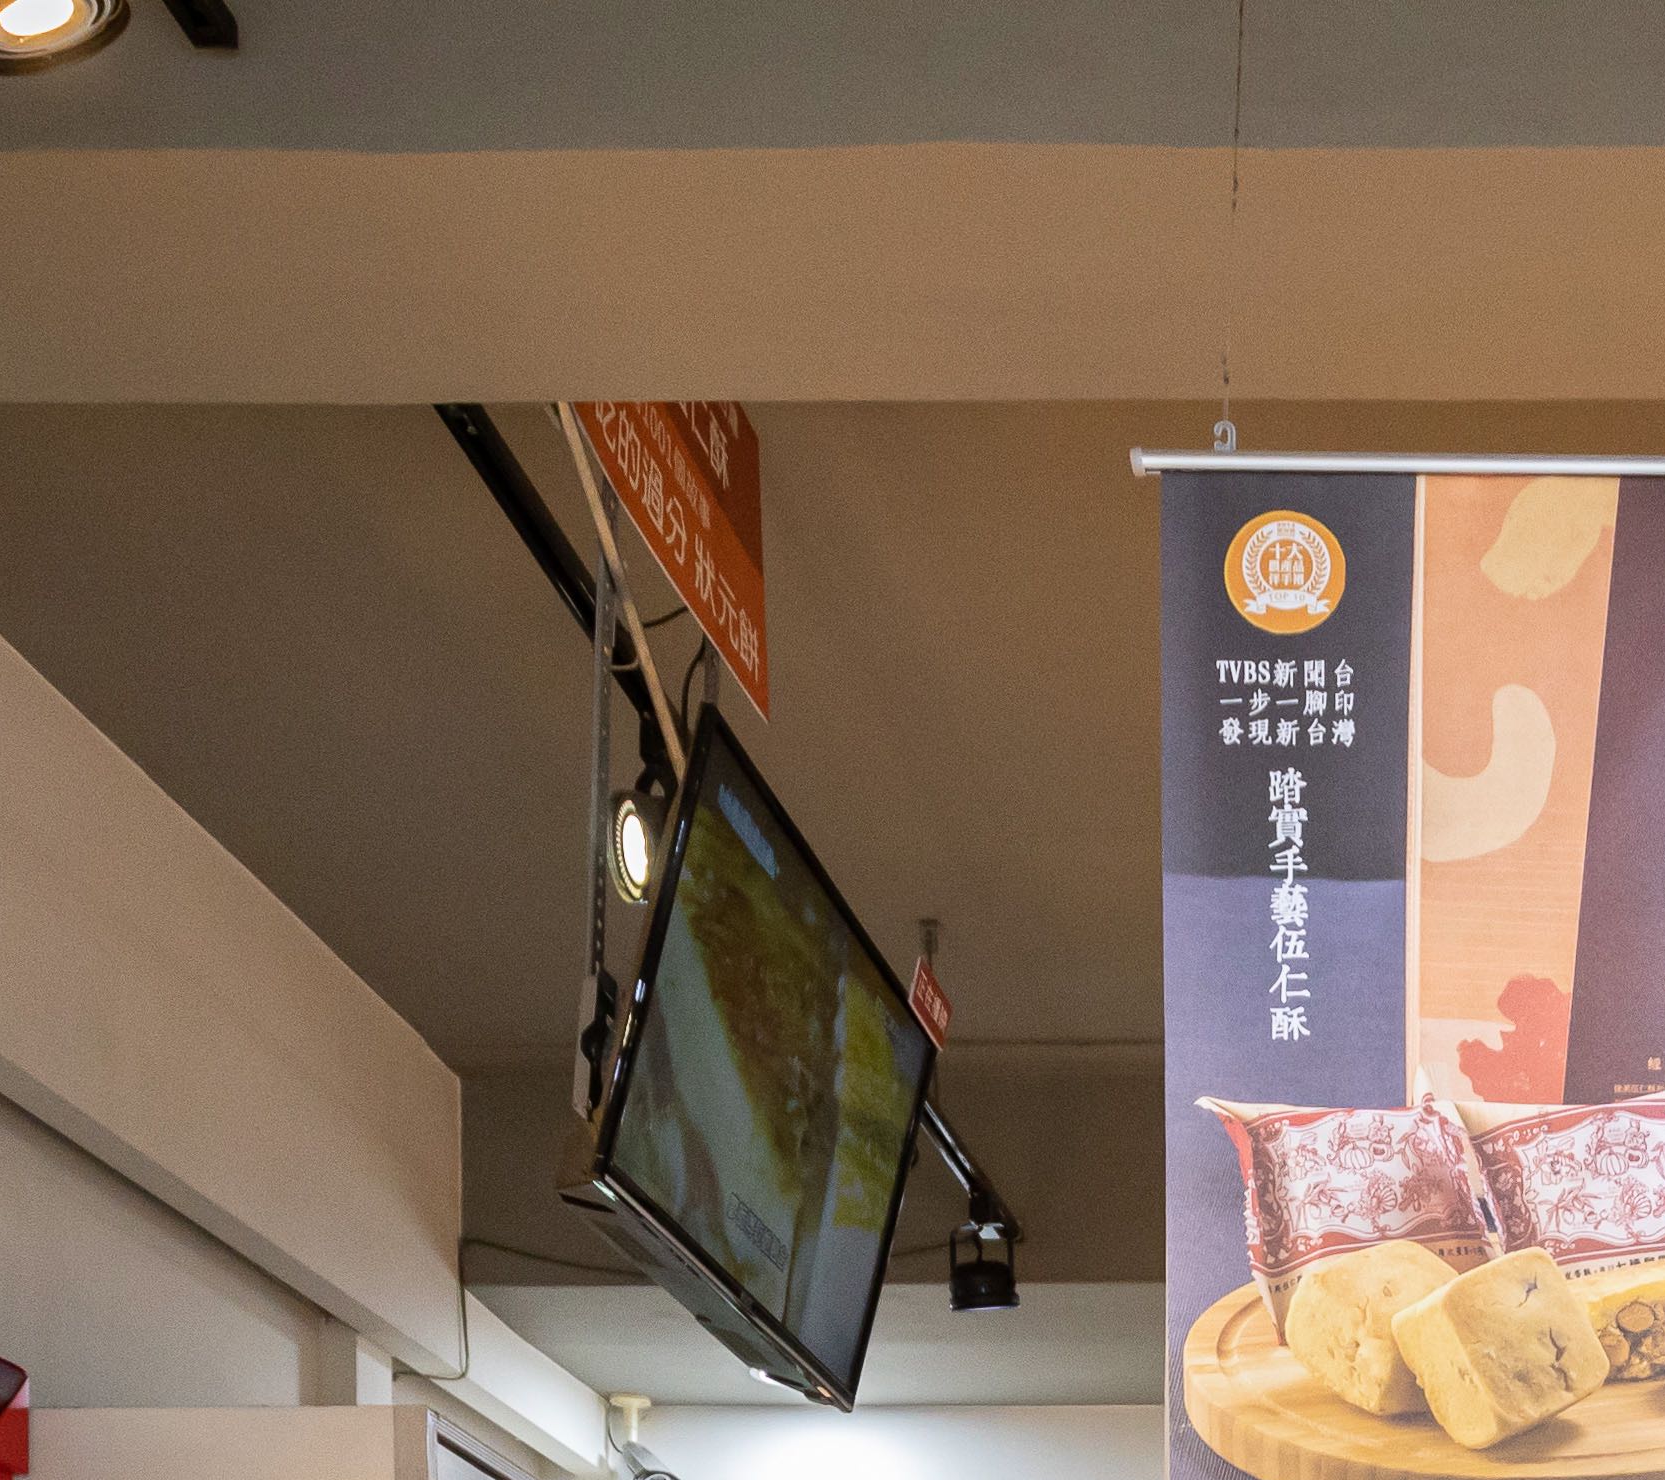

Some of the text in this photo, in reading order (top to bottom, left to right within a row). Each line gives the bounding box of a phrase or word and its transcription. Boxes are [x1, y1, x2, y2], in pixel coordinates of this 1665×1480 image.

[694, 534, 760, 682] 狀元餅
[1216, 658, 1356, 688] TVBS新聞台
[1219, 688, 1355, 717] 一步一腳印
[1219, 717, 1356, 748] 發現新台灣
[1267, 766, 1312, 1041] 踏實手藝伍仁酥
